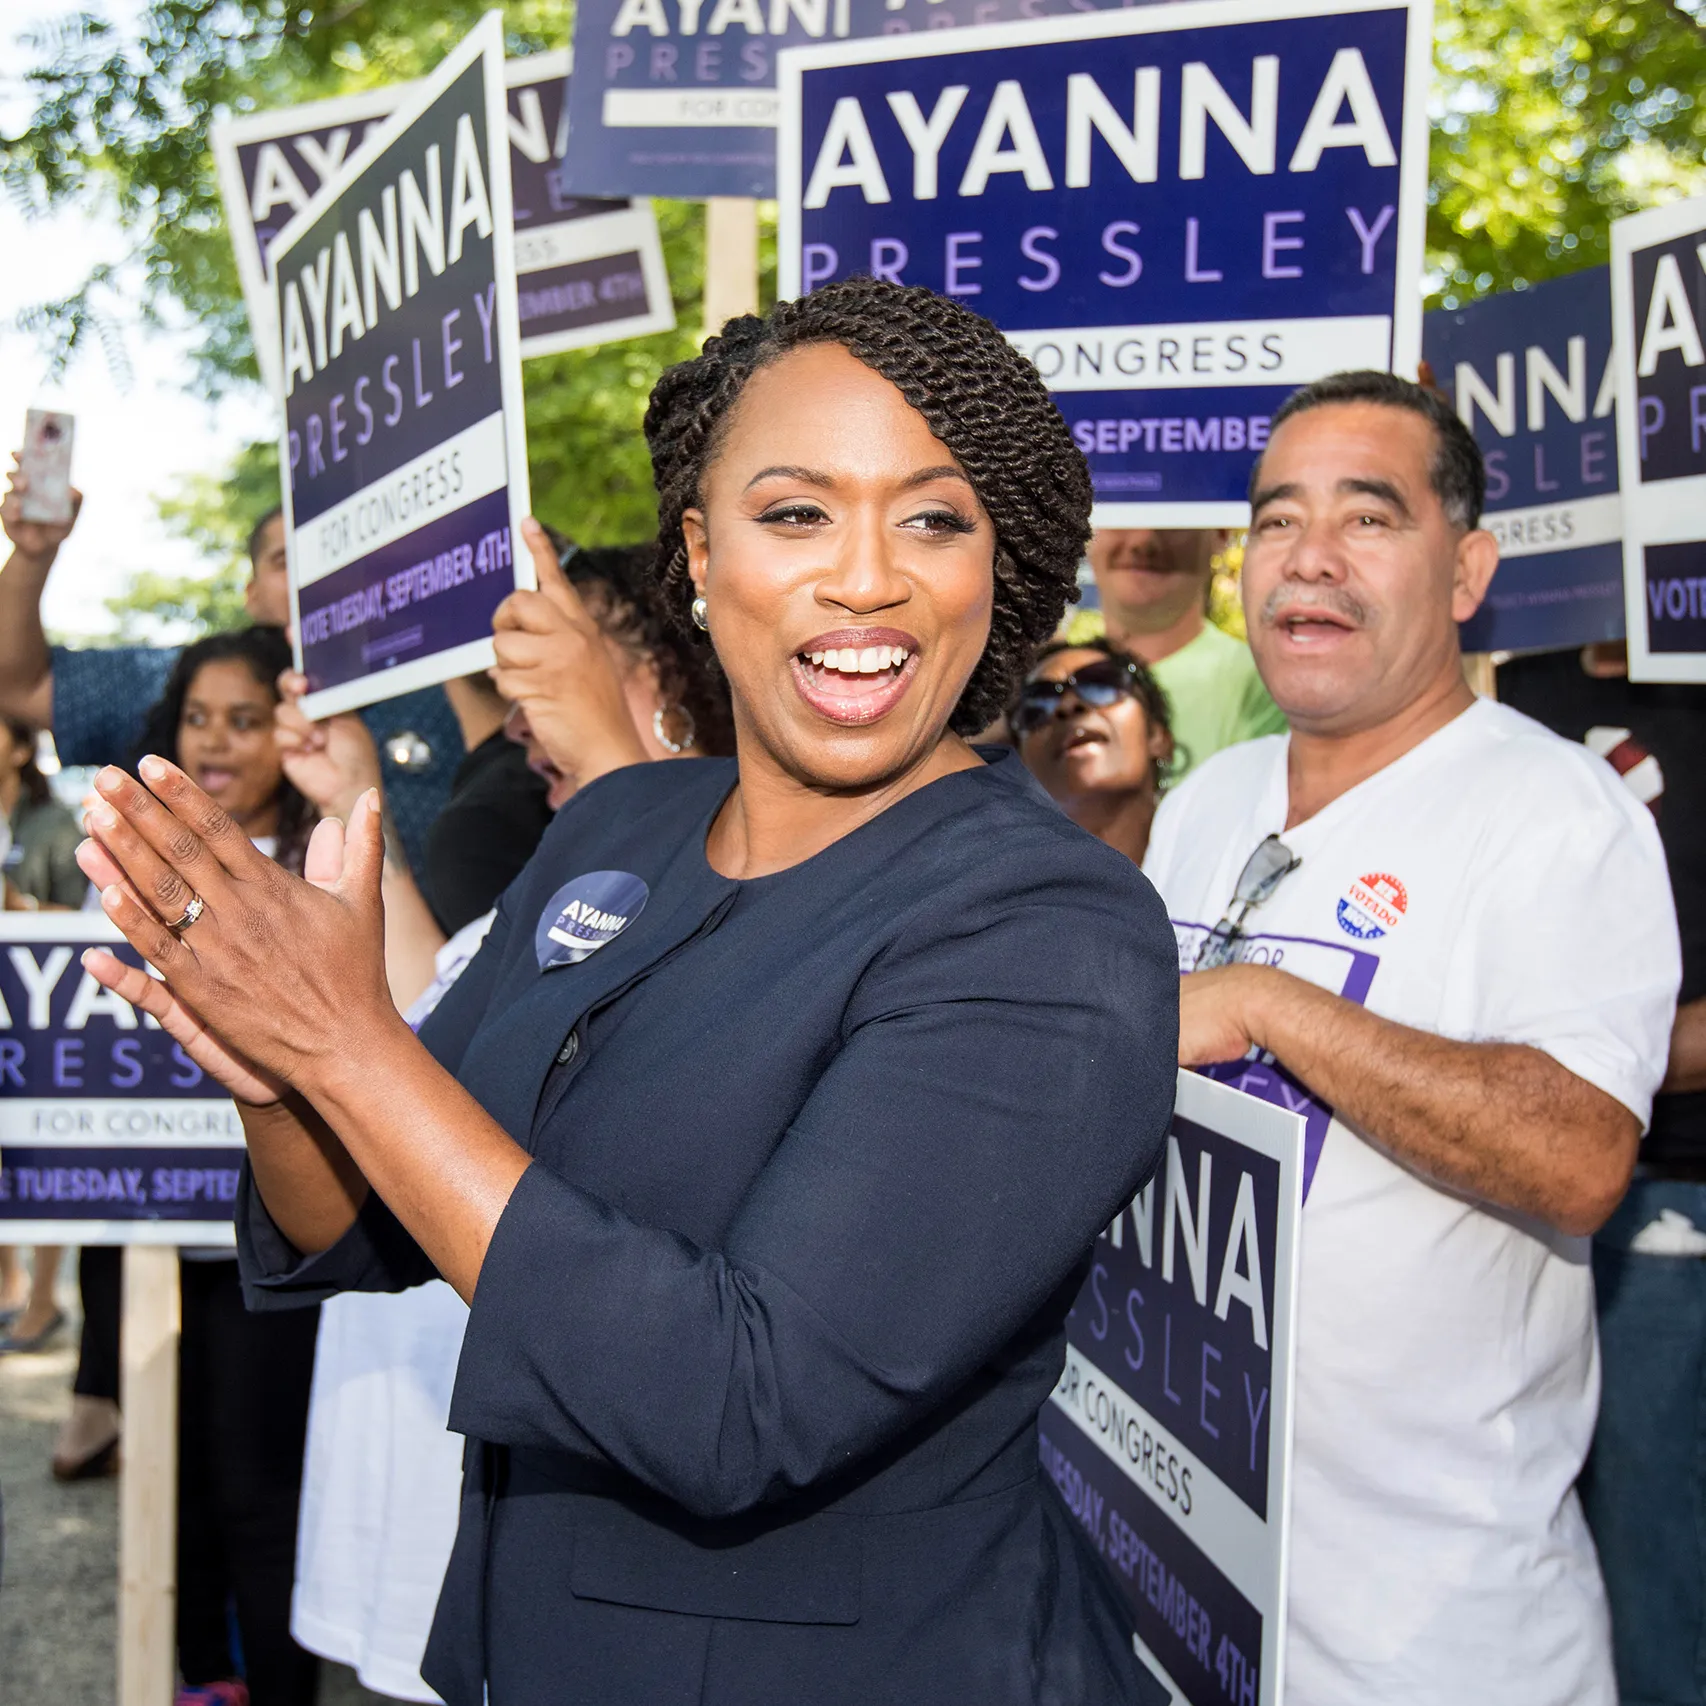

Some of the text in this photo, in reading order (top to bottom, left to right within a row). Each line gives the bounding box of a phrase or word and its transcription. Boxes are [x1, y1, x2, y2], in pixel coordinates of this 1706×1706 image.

[610, 0, 851, 37] AYAN
[803, 47, 1398, 210] AYANNA
[284, 113, 493, 398] AYANNA
[802, 206, 1396, 297] PRESSLEY
[288, 281, 496, 491] PRESSLEY
[1016, 333, 1284, 378] ONGRESS
[357, 450, 464, 543] CONGRESS
[384, 543, 474, 614] SEPTEMBER
[475, 526, 513, 576] 4TH
[562, 900, 628, 932] AYANNA
[1348, 883, 1398, 928] VOTADO
[17, 1167, 147, 1205] TUESDAY,
[152, 1167, 240, 1201] SEPTE
[1066, 1263, 1268, 1471] SSLEY
[1086, 1380, 1193, 1517] CONGRESS
[1108, 1510, 1213, 1673] SEPTEMBER
